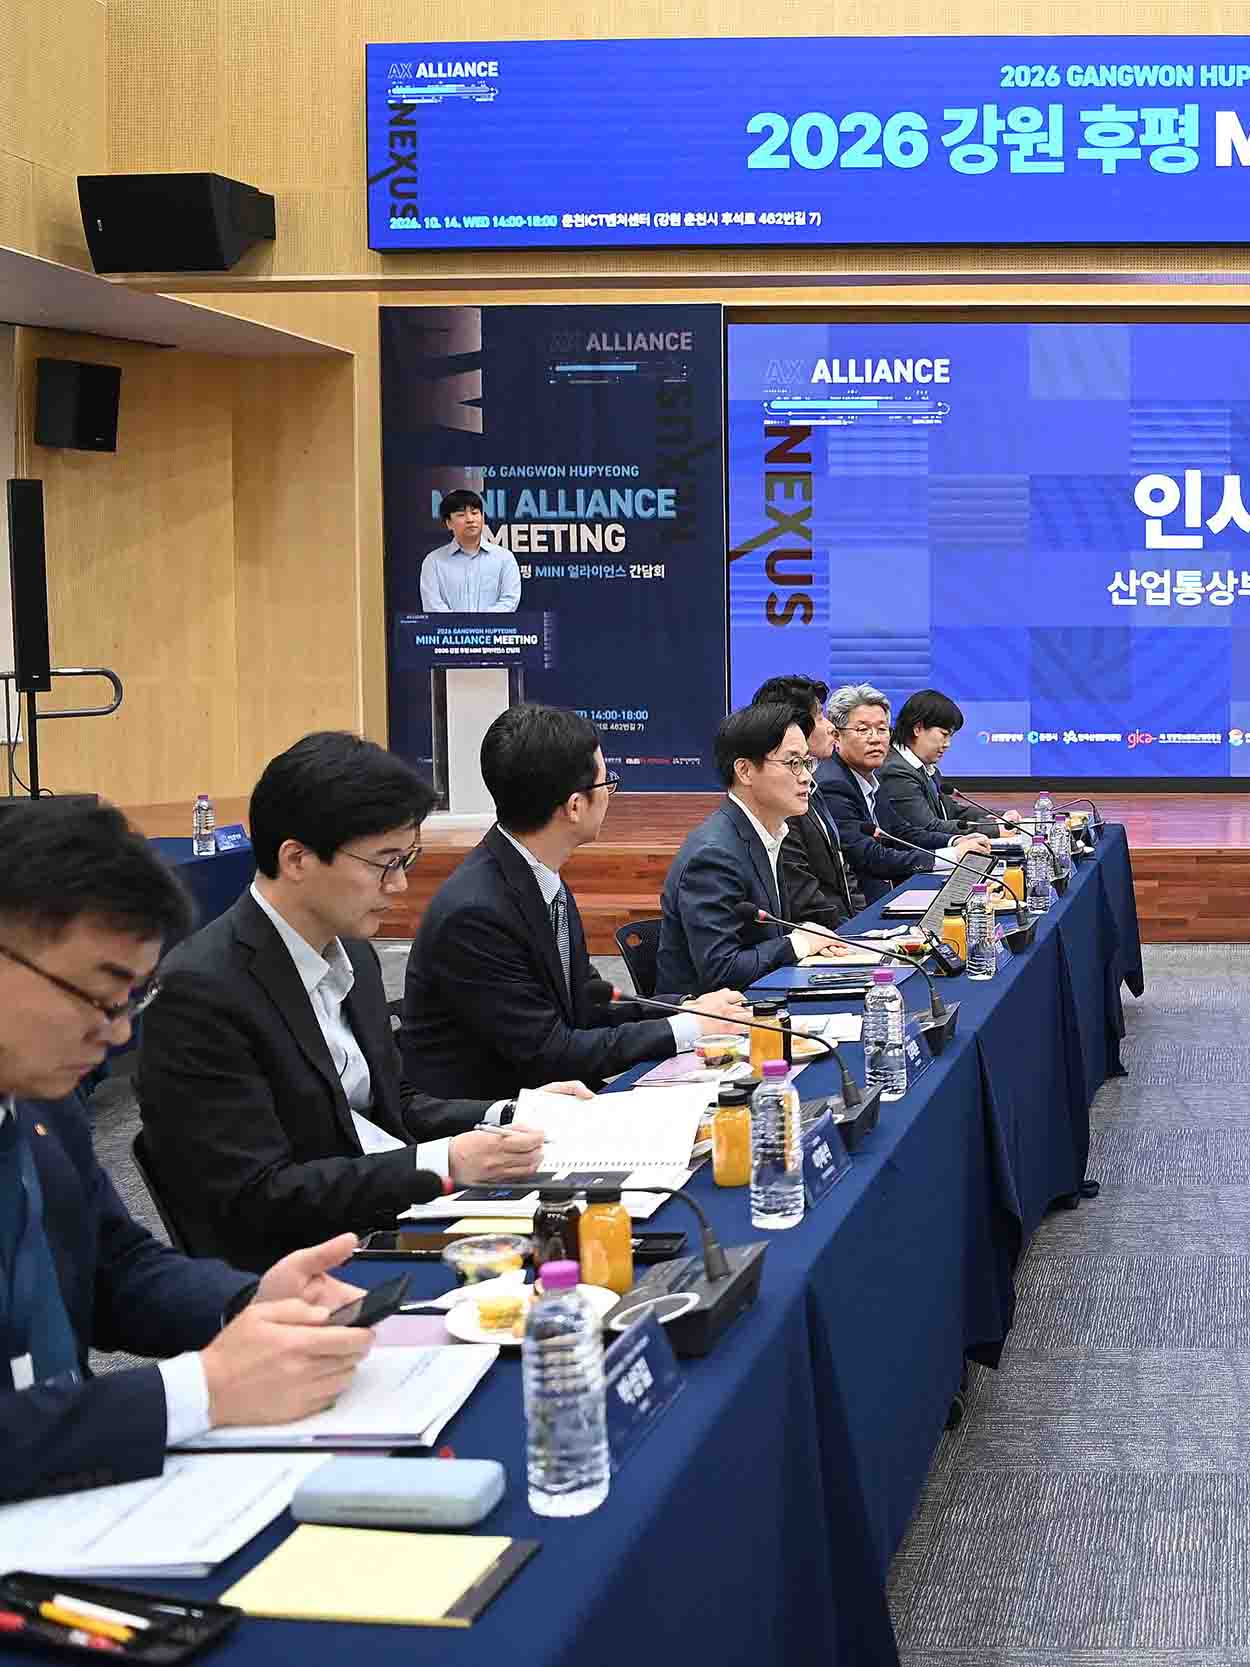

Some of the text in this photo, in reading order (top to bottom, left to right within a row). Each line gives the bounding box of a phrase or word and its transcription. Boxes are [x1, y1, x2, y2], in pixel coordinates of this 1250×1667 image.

[416, 61, 499, 78] ALLIANCE
[1001, 65, 1061, 88] 2026
[1067, 65, 1193, 88] GANGWON
[746, 111, 929, 170] 2026
[940, 104, 1065, 175] 강원
[1077, 104, 1200, 175] 후평
[463, 215, 490, 228] WED
[586, 331, 693, 351] ALLIANCE
[810, 358, 950, 384] ALLIANCE
[500, 464, 566, 478] GANGWON
[569, 464, 640, 478] HUPYEONG
[514, 488, 677, 519] ALLIANCE
[729, 425, 814, 627] NEXUS
[535, 565, 565, 577] MINI
[567, 565, 627, 579] 얼라이언스
[629, 564, 665, 579] 간담회
[415, 634, 539, 645] MINI ALLIANCE MEETING
[590, 710, 649, 721] 14:00-18:00
